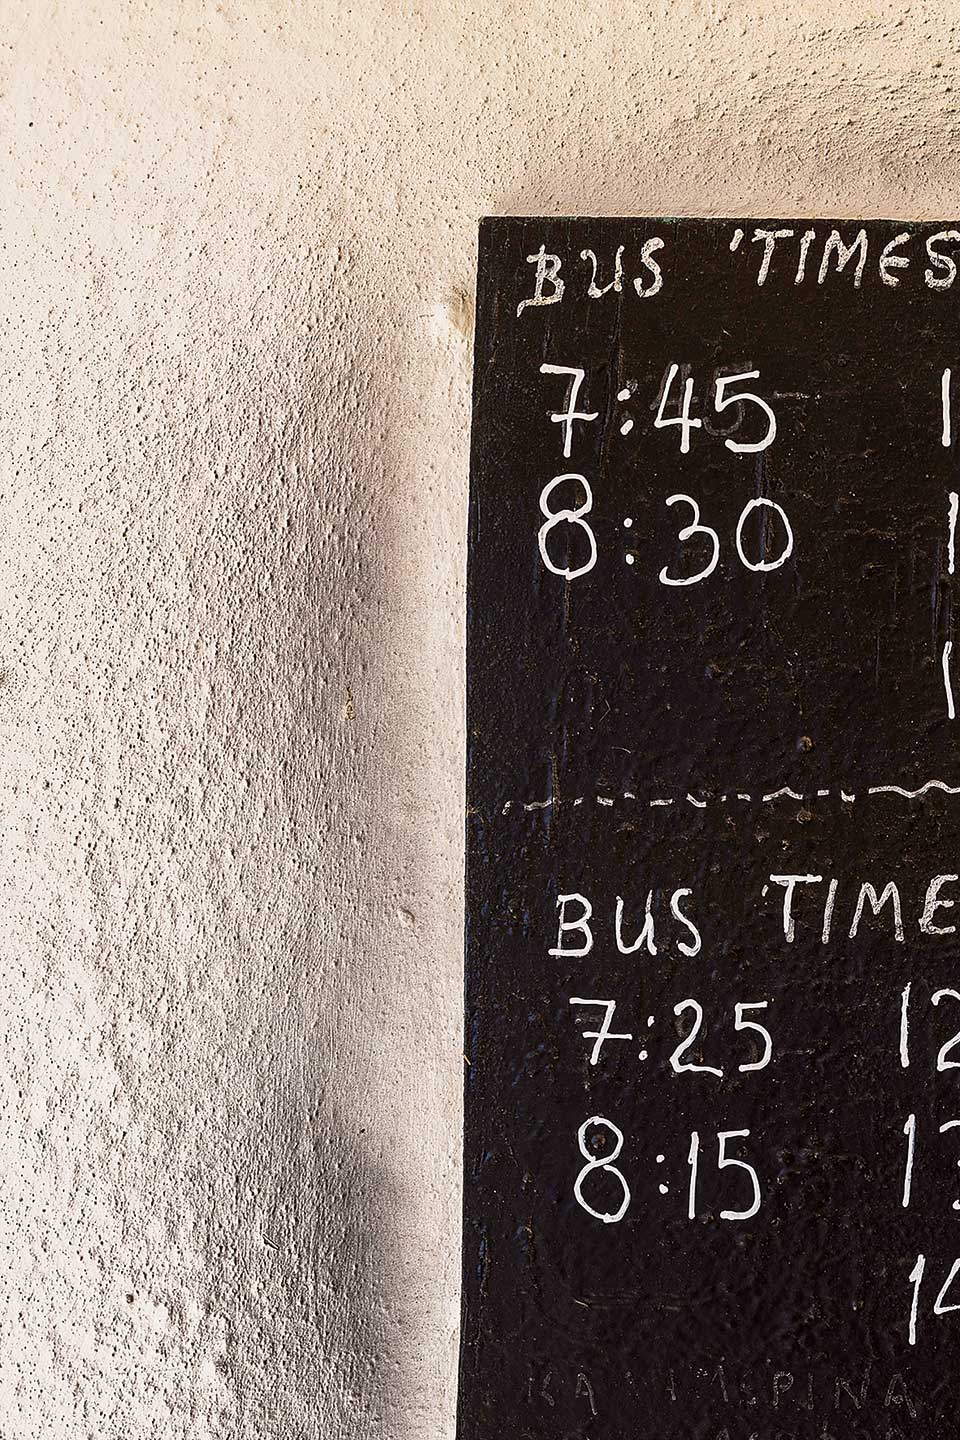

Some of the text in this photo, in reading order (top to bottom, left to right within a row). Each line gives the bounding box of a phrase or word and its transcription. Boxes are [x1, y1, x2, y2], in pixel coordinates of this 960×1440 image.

[516, 236, 665, 318] BUS
[539, 363, 777, 459] 7:45
[537, 473, 794, 586] 8:30
[547, 887, 702, 958] BUS
[568, 997, 773, 1078] 7:25
[573, 1115, 762, 1224] 8:15
